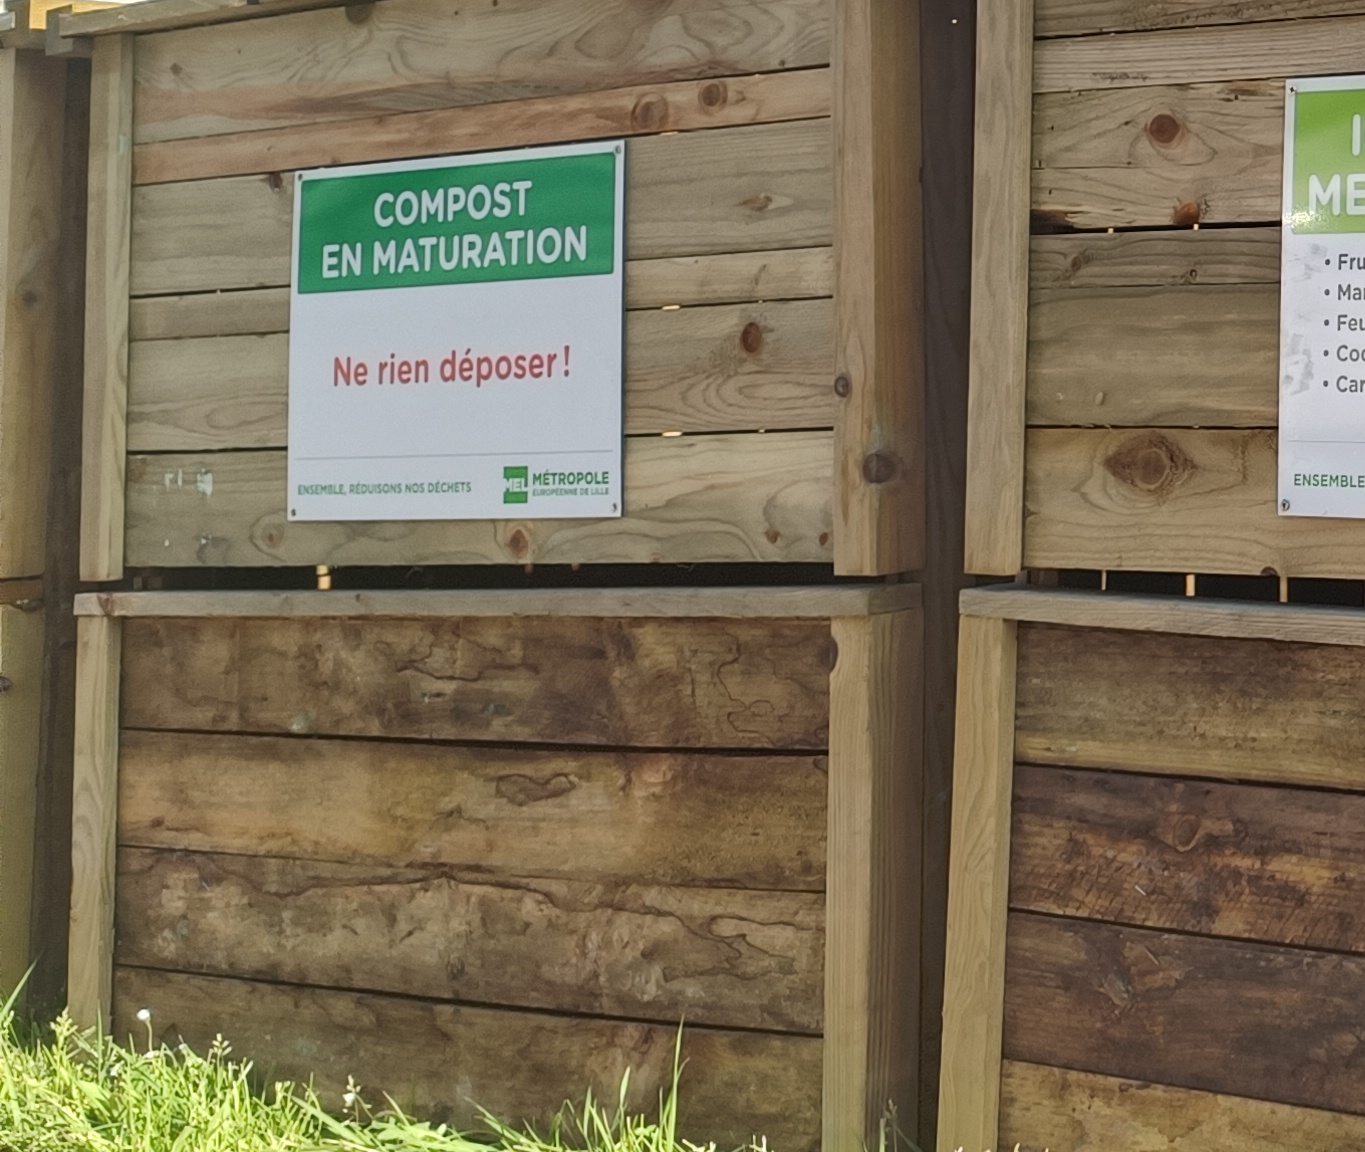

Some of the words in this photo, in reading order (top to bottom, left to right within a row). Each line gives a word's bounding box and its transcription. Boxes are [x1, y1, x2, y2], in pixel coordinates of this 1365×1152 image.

[374, 180, 532, 227] COMPOST
[322, 241, 361, 278] EN
[373, 225, 586, 275] MATURATION
[333, 356, 368, 386] Ne
[378, 352, 428, 385] rien
[297, 483, 346, 495] ENSEMBLE,
[349, 482, 402, 494] RÉDUISONS
[404, 482, 425, 493] NOS
[427, 480, 471, 493] DÉCHETS
[532, 471, 609, 485] MÉTROPOLE
